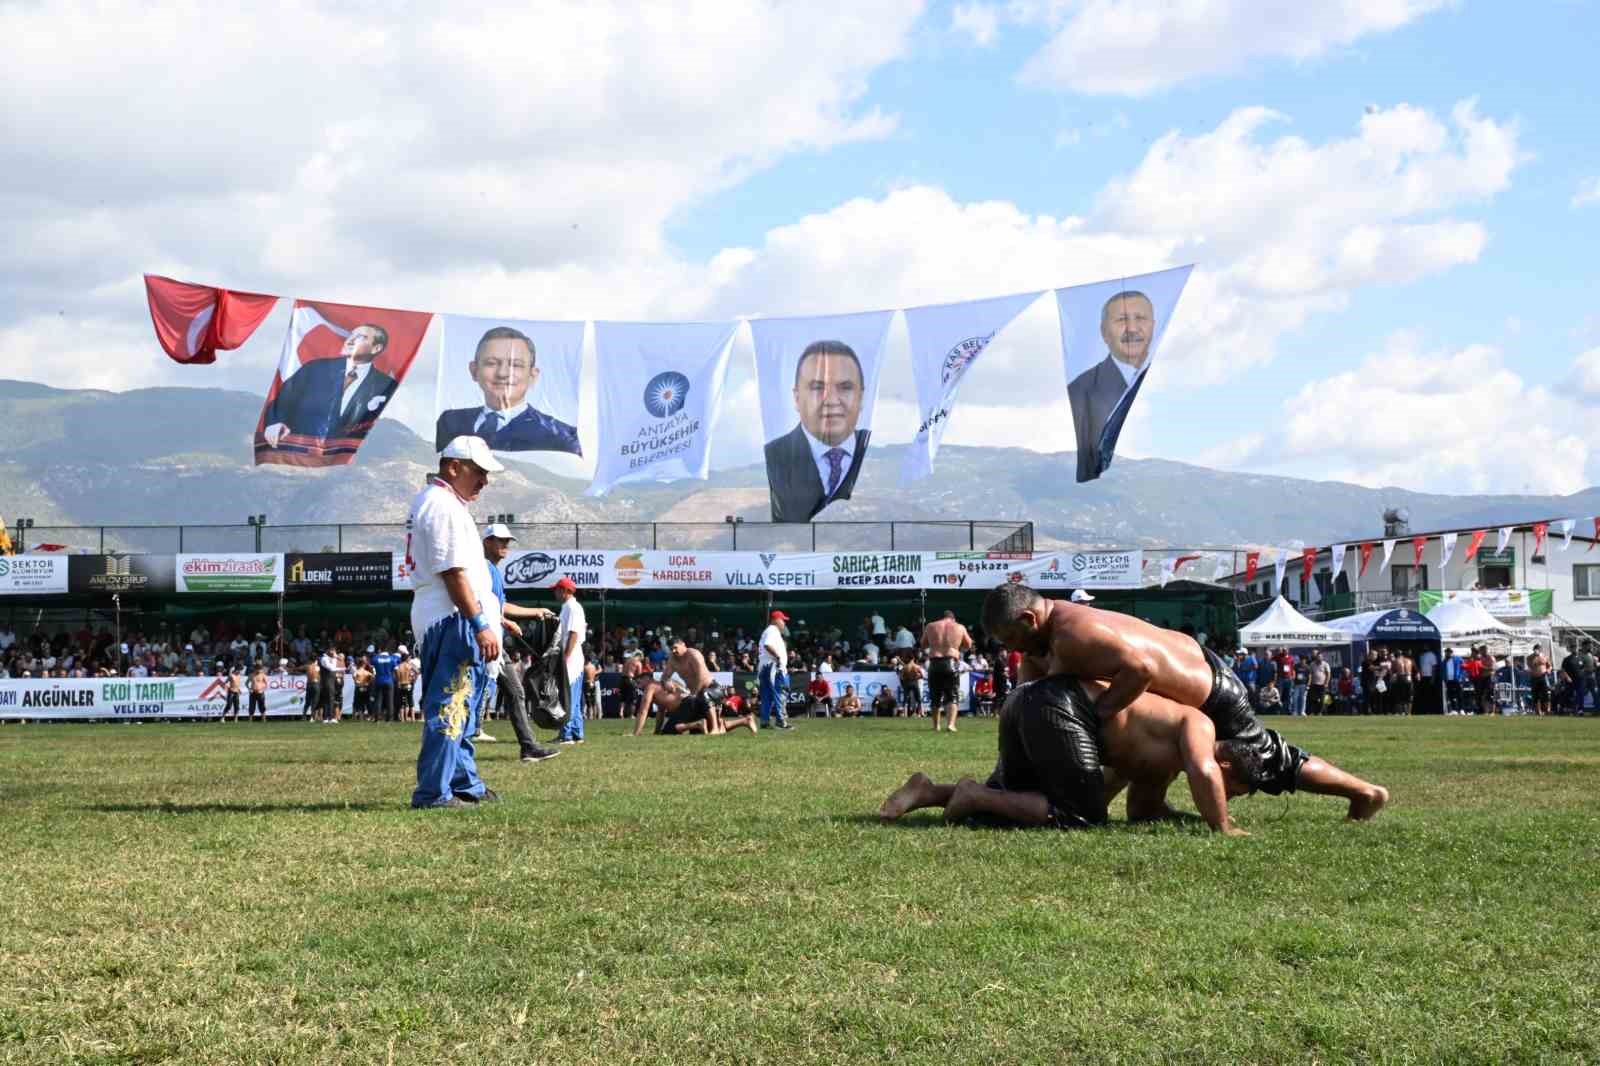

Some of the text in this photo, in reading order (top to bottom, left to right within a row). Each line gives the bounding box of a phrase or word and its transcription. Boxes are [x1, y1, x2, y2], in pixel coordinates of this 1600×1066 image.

[559, 554, 604, 567] KAFKAS
[833, 554, 921, 573] SARICA TARIM
[652, 570, 712, 583] KARDEŞLER
[726, 569, 815, 586] VİLLA SEPETİ
[838, 575, 915, 585] RECEP SARICA
[22, 684, 94, 707] AKGÜNLER
[102, 680, 175, 701] EKDİ TARIM
[113, 702, 164, 714] VELİ EKDİ
